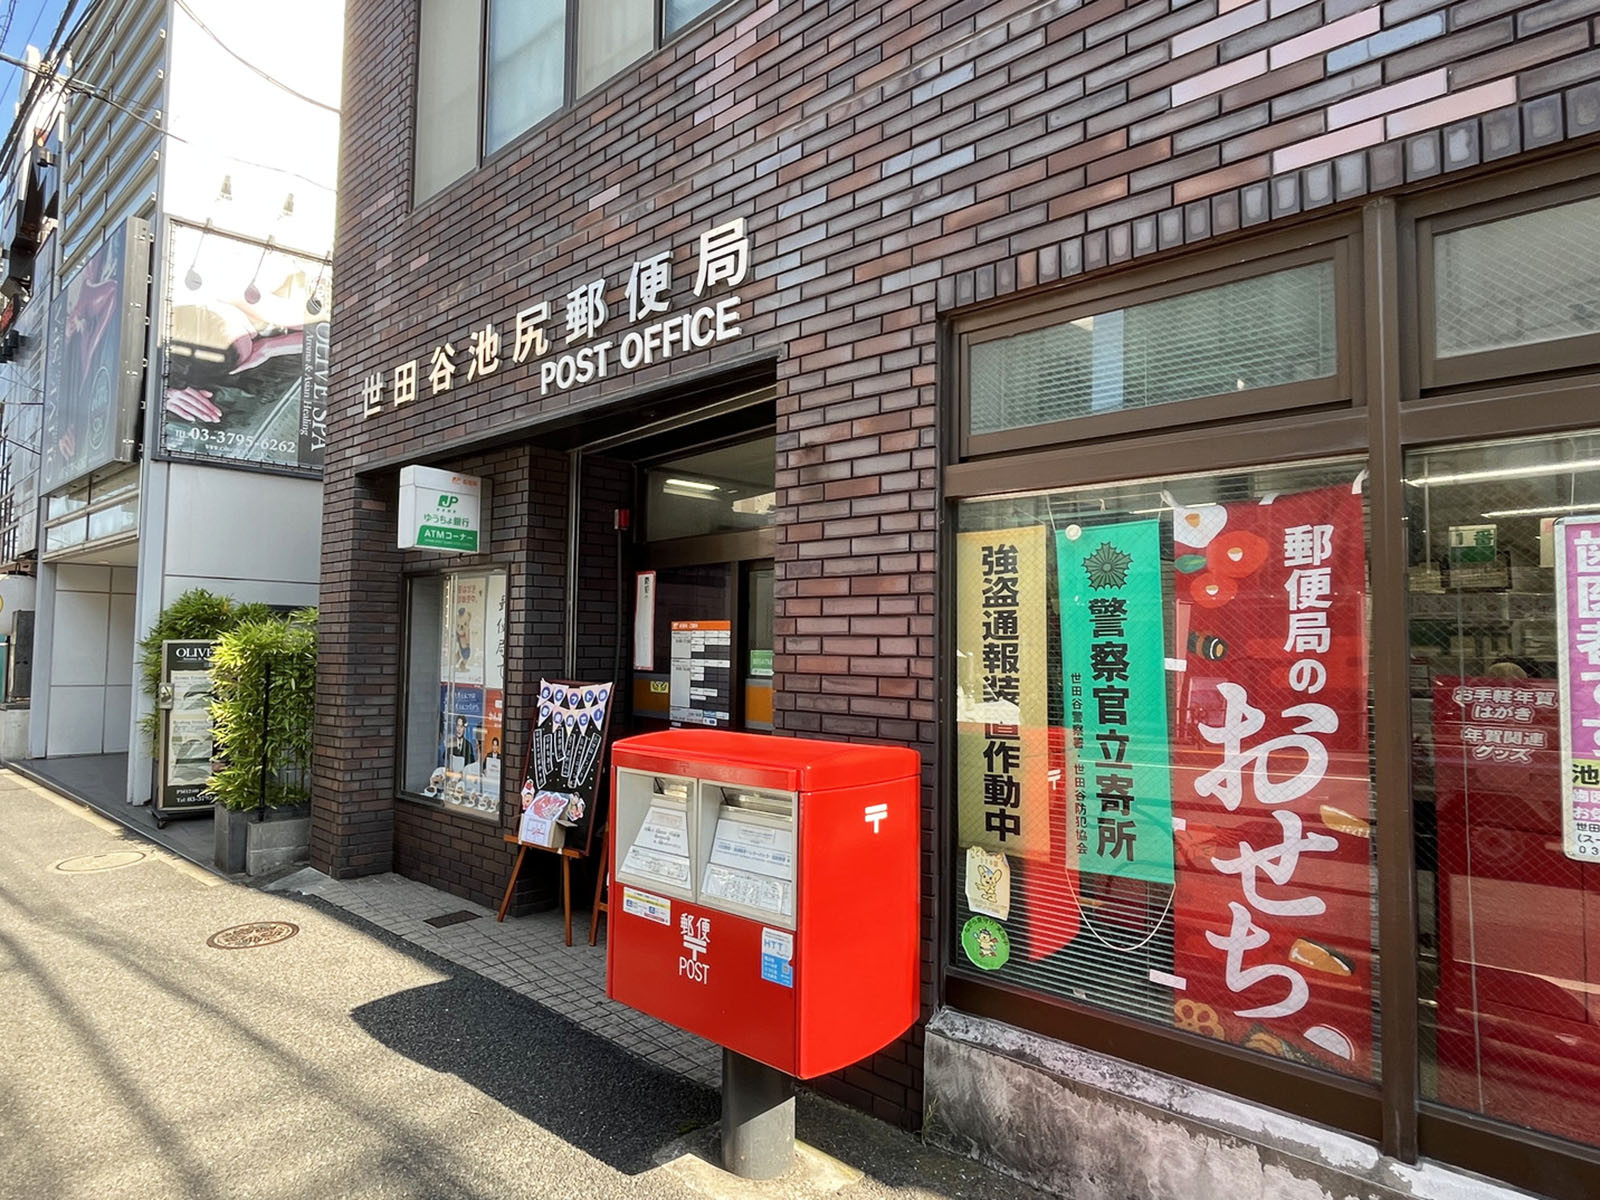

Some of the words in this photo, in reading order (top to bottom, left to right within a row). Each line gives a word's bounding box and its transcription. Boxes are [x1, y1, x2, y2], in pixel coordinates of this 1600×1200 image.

[362, 217, 749, 418] 世田谷池尻郵便局
[541, 341, 613, 395] POST
[620, 296, 743, 370] OFFICE
[423, 513, 470, 528] ゆうちょ銀行
[424, 529, 474, 541] ATMコーナー
[1283, 524, 1334, 695] 郵便局の
[1454, 689, 1556, 707] お手軽年賀
[1475, 705, 1532, 720] はがき
[1088, 597, 1137, 862] 警察官立寄所
[1464, 728, 1545, 747] 年賀関連
[1194, 682, 1339, 1018] おせち
[680, 913, 711, 943] 郵便
[679, 956, 711, 985] POST
